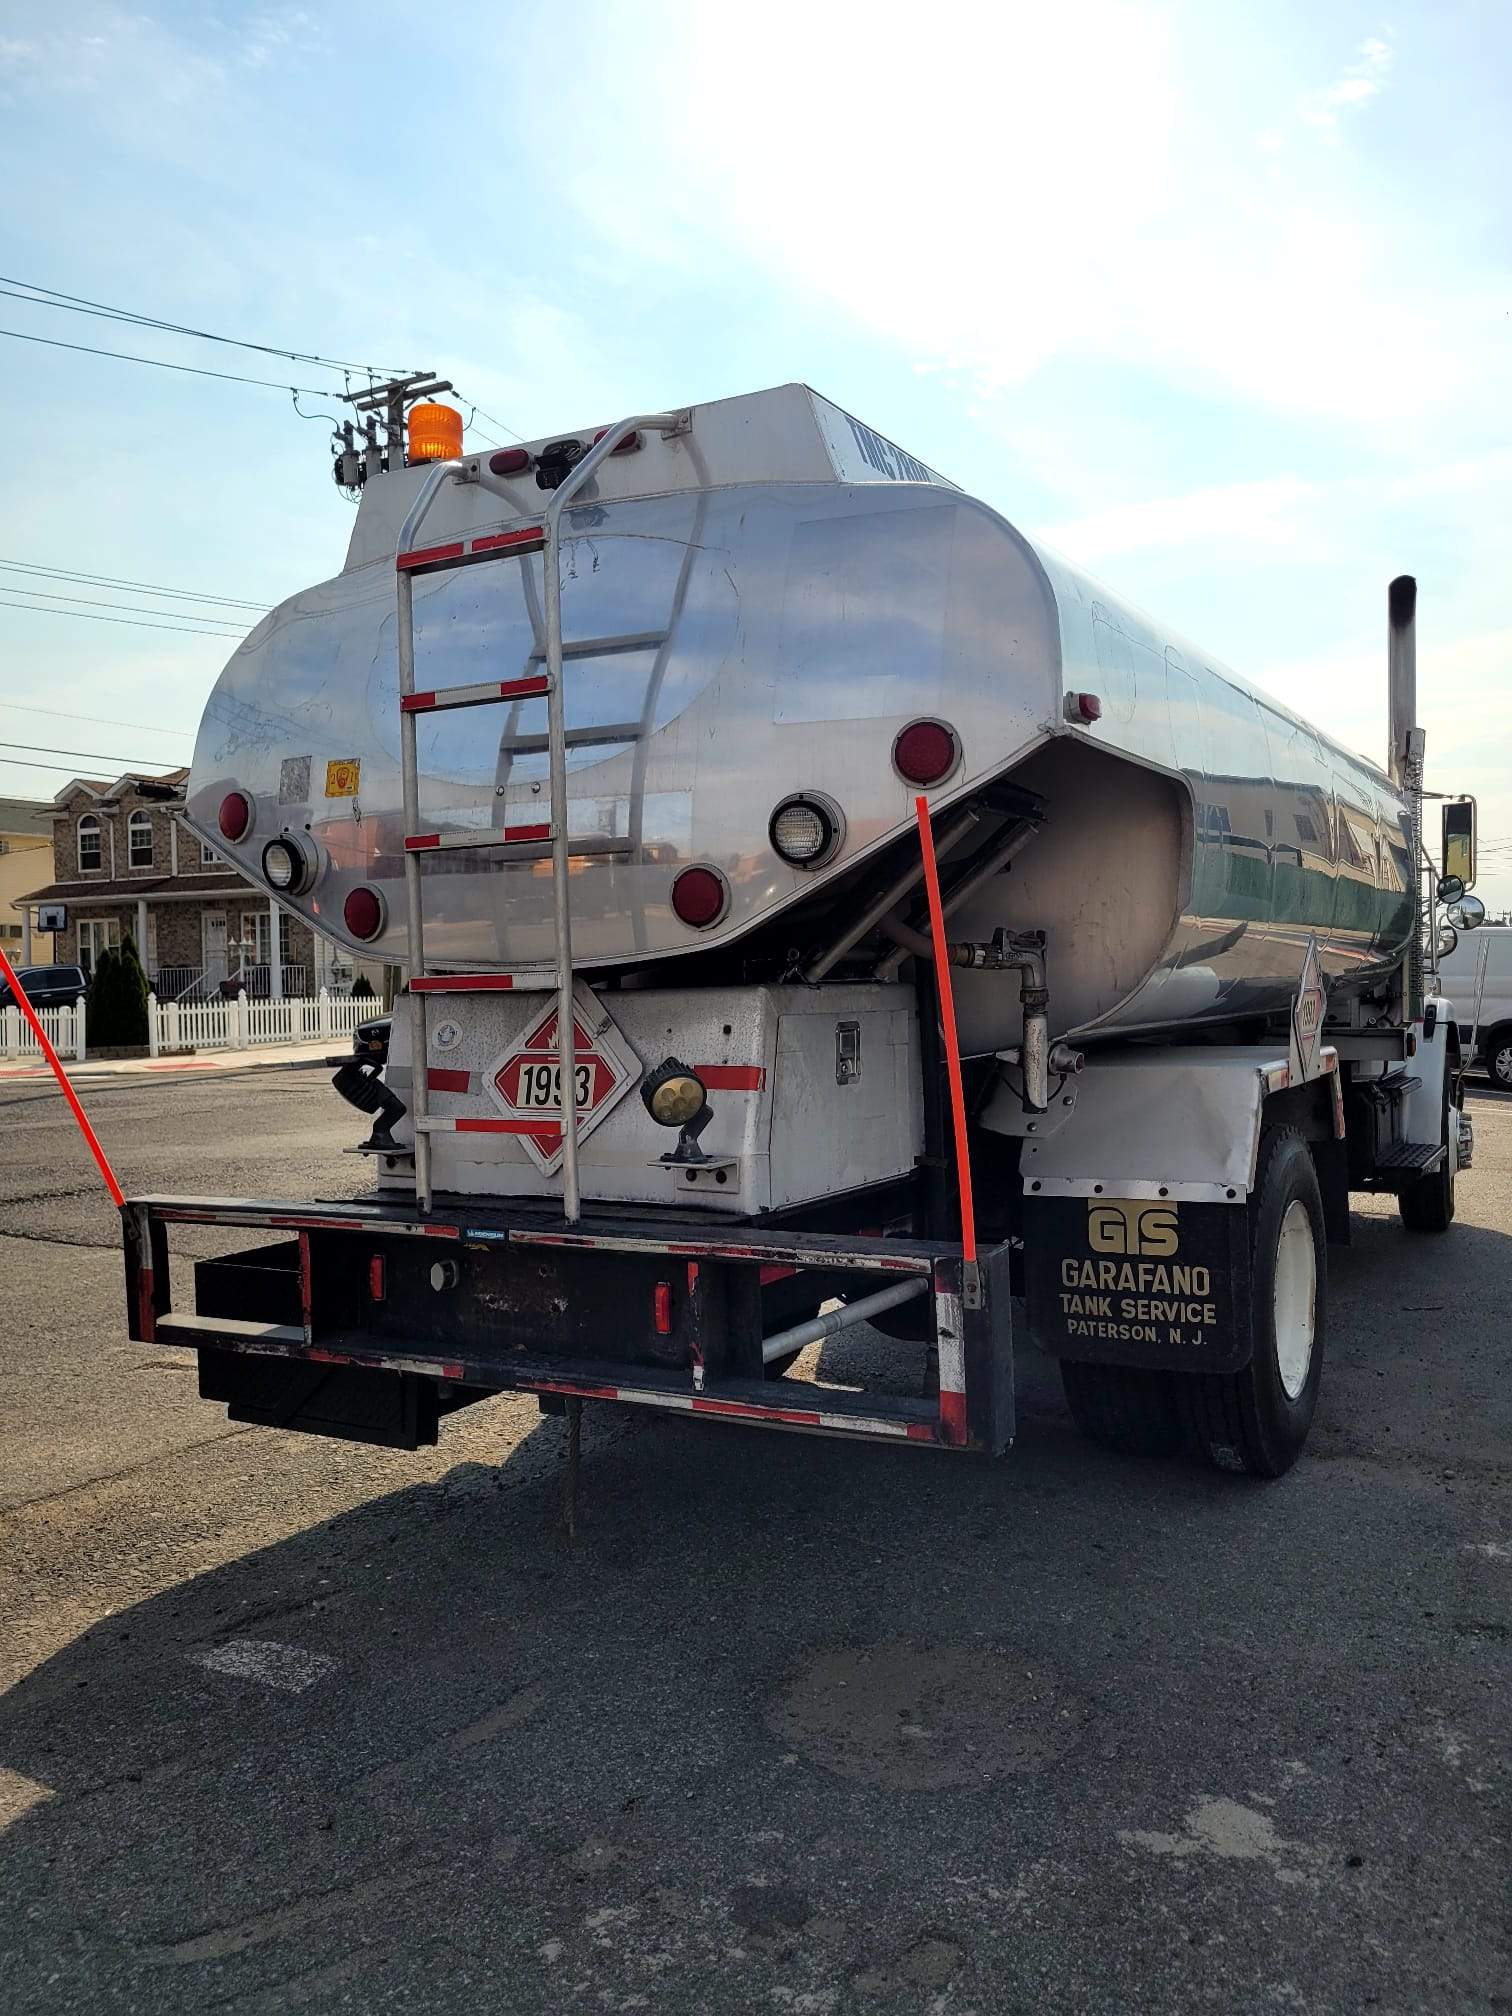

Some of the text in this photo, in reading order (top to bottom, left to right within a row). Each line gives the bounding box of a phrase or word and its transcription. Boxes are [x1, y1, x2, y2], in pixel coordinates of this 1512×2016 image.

[1088, 1199, 1179, 1257] GTS
[1061, 1258, 1210, 1296] GARAFANO
[1059, 1293, 1217, 1325] TANK SERVICE
